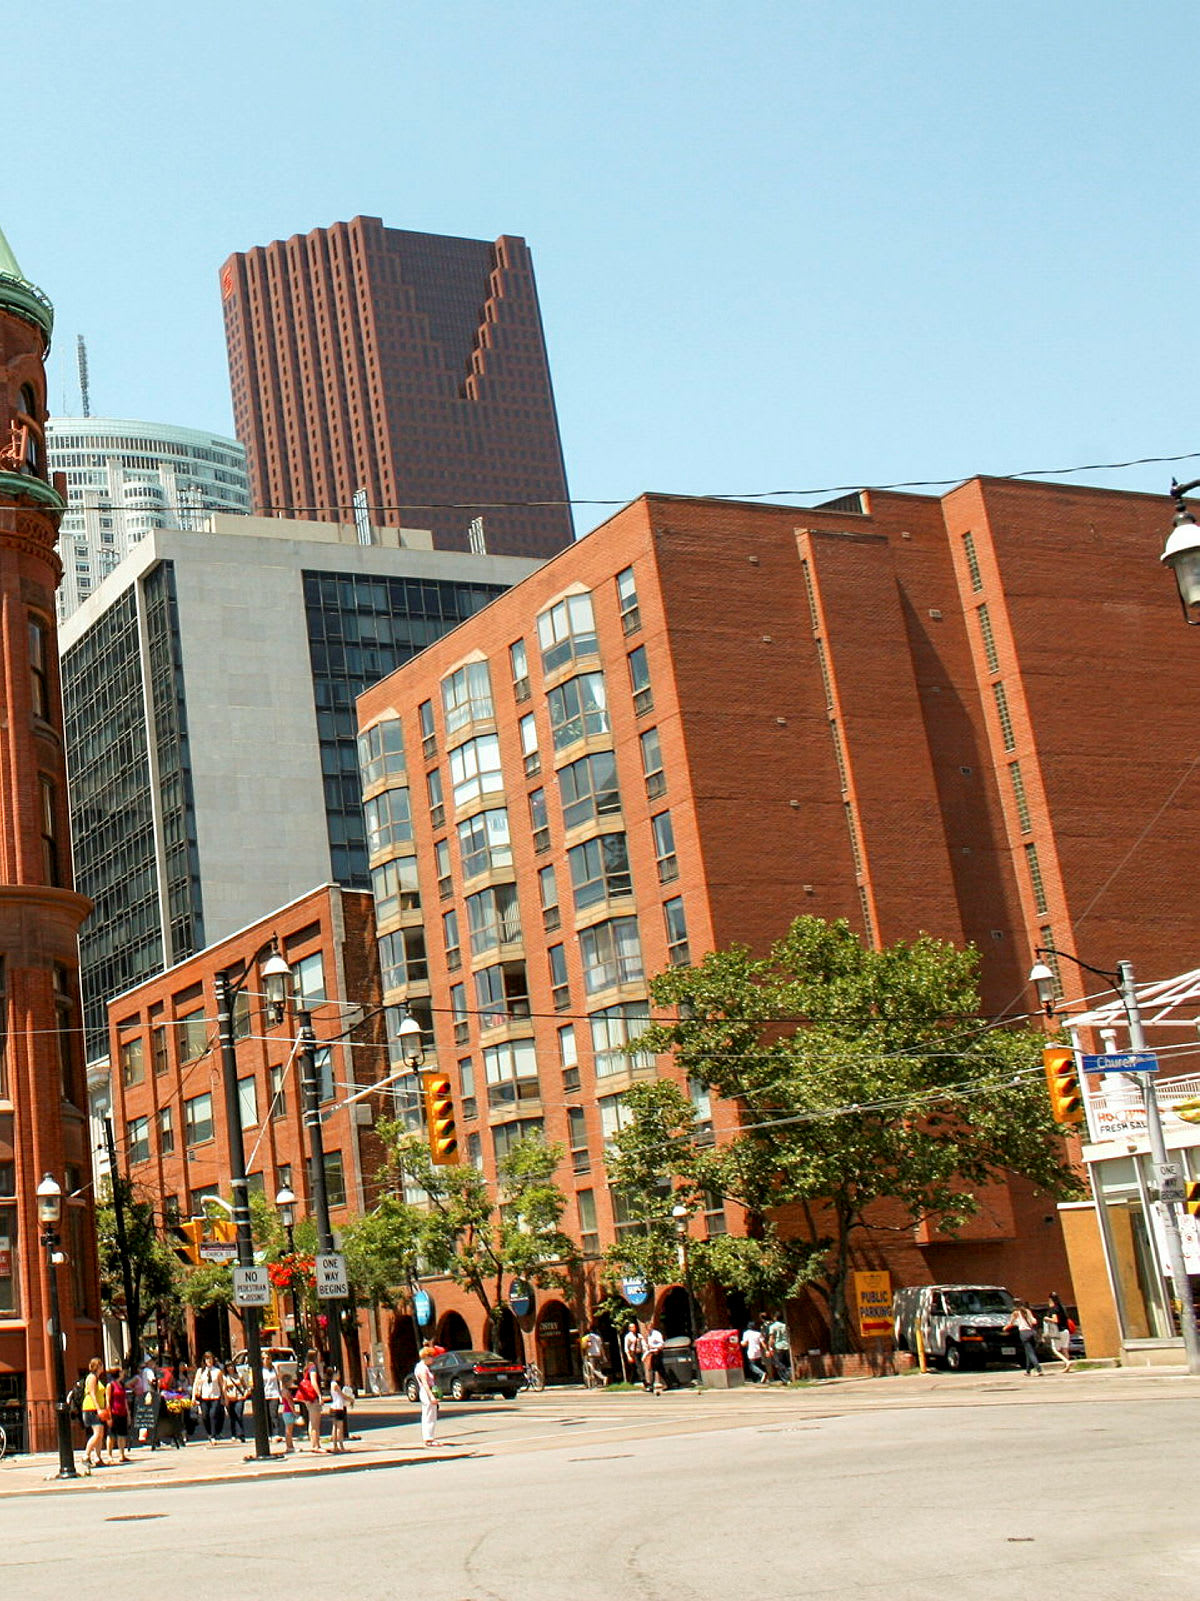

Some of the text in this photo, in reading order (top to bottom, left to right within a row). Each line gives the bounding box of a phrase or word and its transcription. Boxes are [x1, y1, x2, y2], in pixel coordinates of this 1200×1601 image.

[1096, 1056, 1136, 1069] Church
[1100, 1123, 1128, 1133] FRESH
[1160, 1165, 1177, 1175] ONE
[322, 1258, 338, 1268] ONE
[245, 1271, 258, 1282] NO
[324, 1271, 338, 1281] WAY
[237, 1283, 267, 1293] PEDESTRIAN
[319, 1284, 347, 1294] BEGINS
[860, 1291, 888, 1303] PUBLIC
[859, 1305, 893, 1317] PARKING
